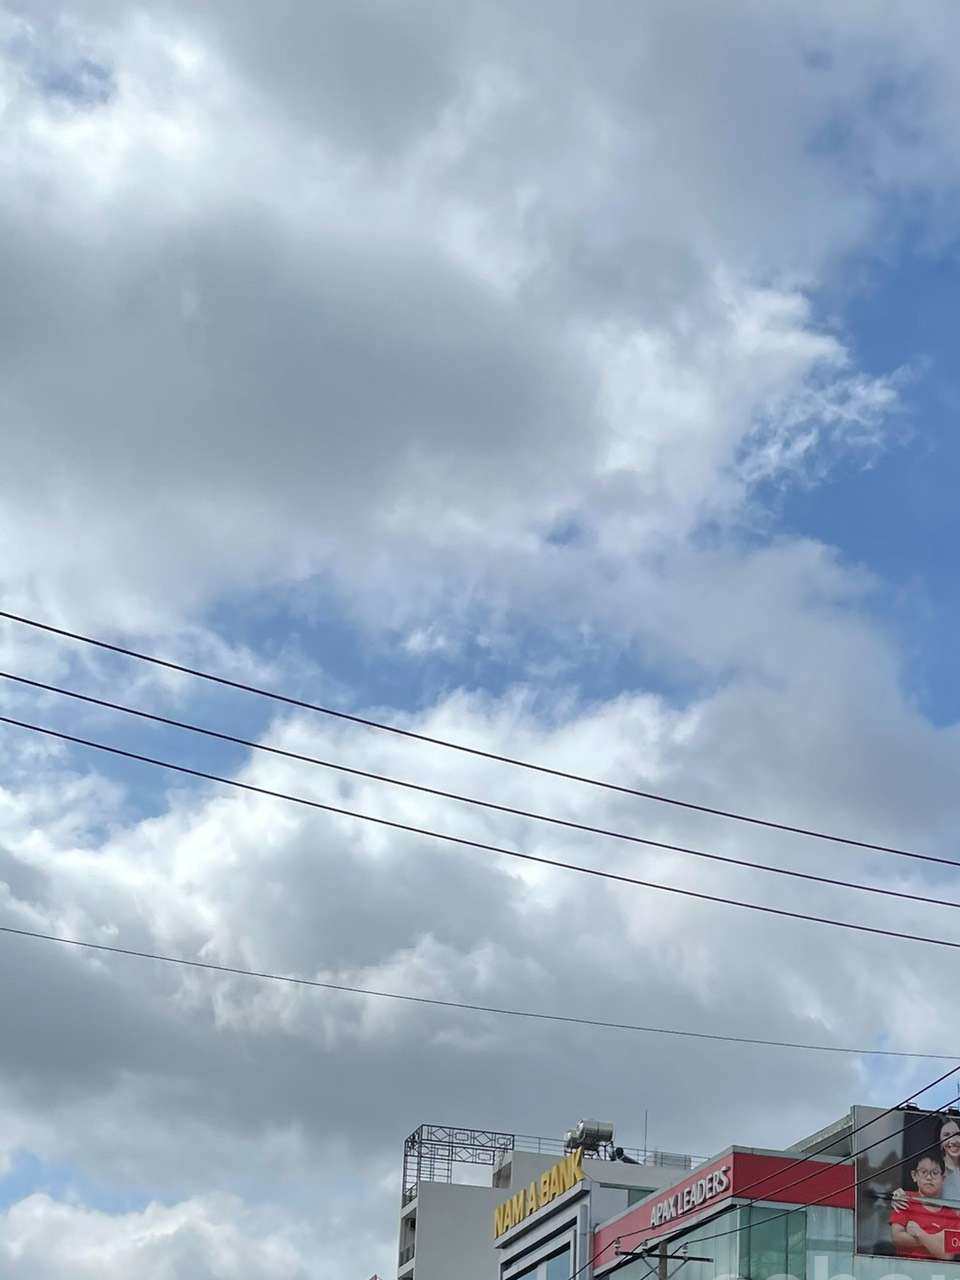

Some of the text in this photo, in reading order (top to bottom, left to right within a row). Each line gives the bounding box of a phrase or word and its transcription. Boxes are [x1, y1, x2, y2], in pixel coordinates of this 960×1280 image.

[494, 1145, 585, 1239] NAM A BANK
[651, 1166, 731, 1228] APAX LEADERS
